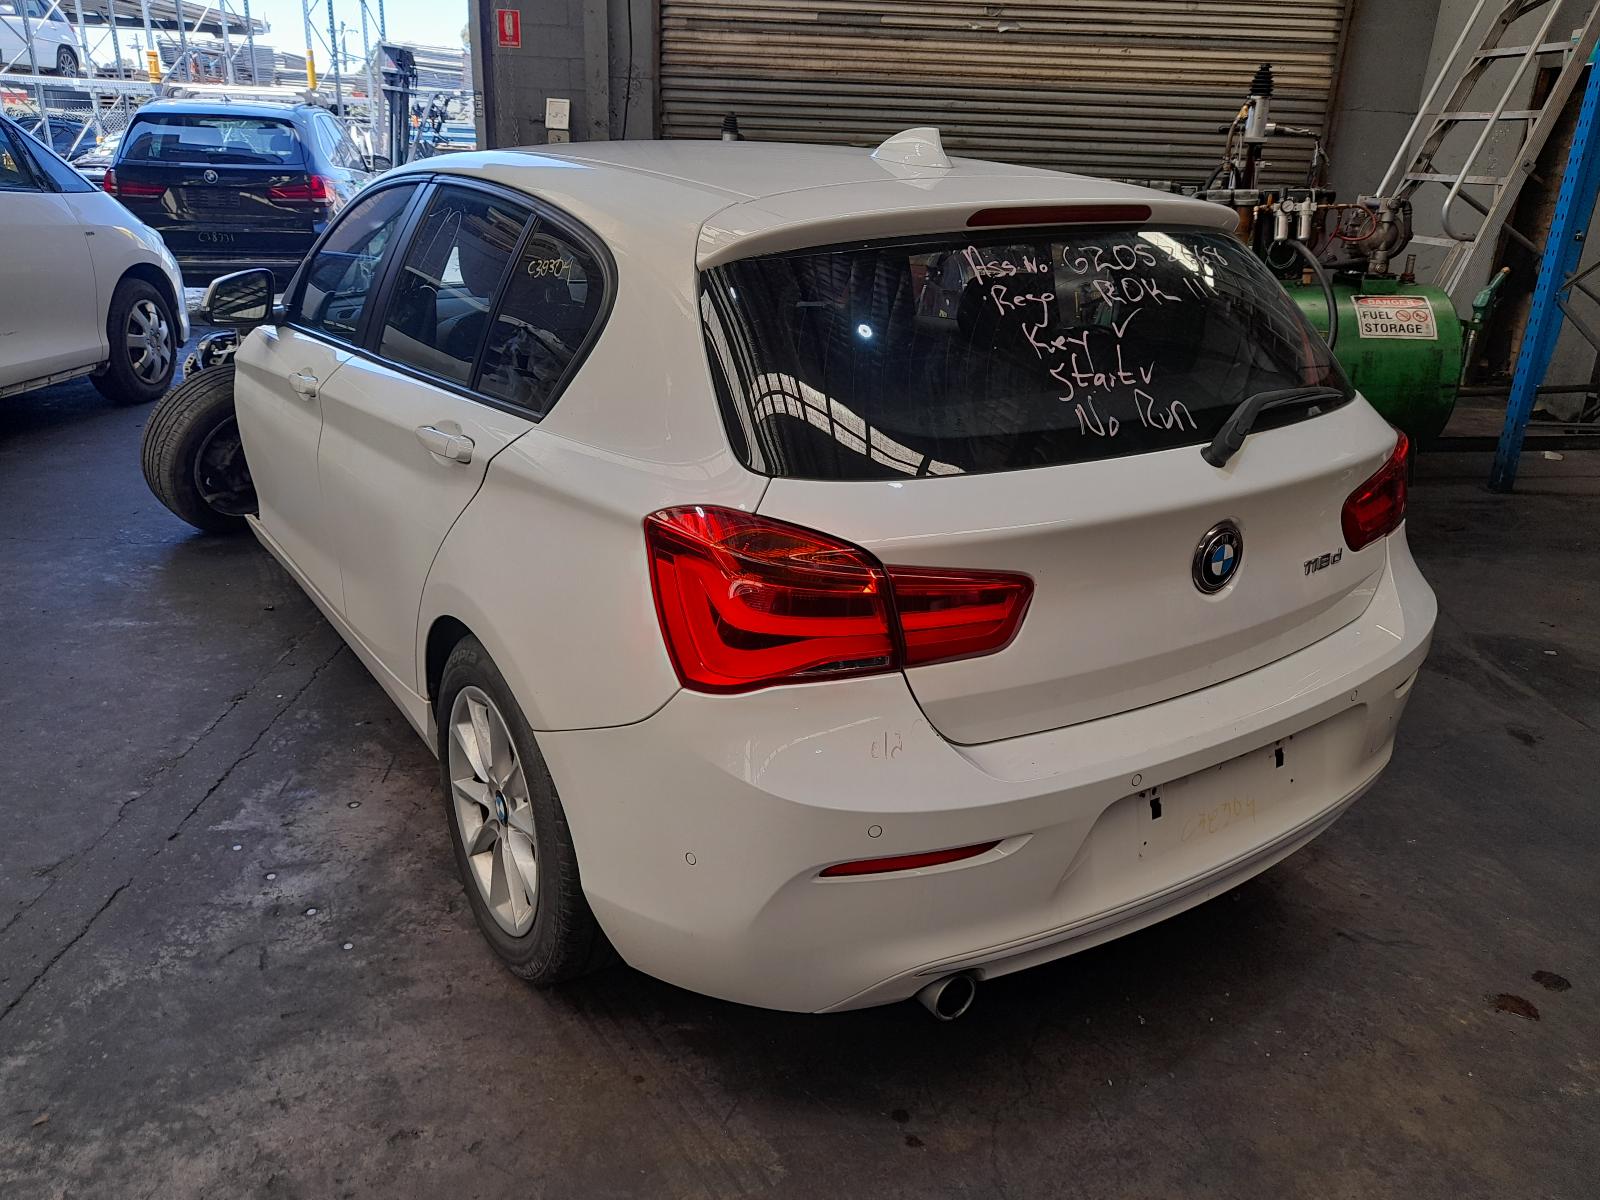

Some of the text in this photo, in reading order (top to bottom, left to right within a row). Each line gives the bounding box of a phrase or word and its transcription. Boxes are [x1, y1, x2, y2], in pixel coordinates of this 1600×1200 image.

[991, 285, 1055, 328] Rego
[1367, 298, 1414, 306] DANGER
[1362, 311, 1393, 320] FUEL
[1364, 323, 1423, 334] STORAGE
[1075, 395, 1120, 437] No
